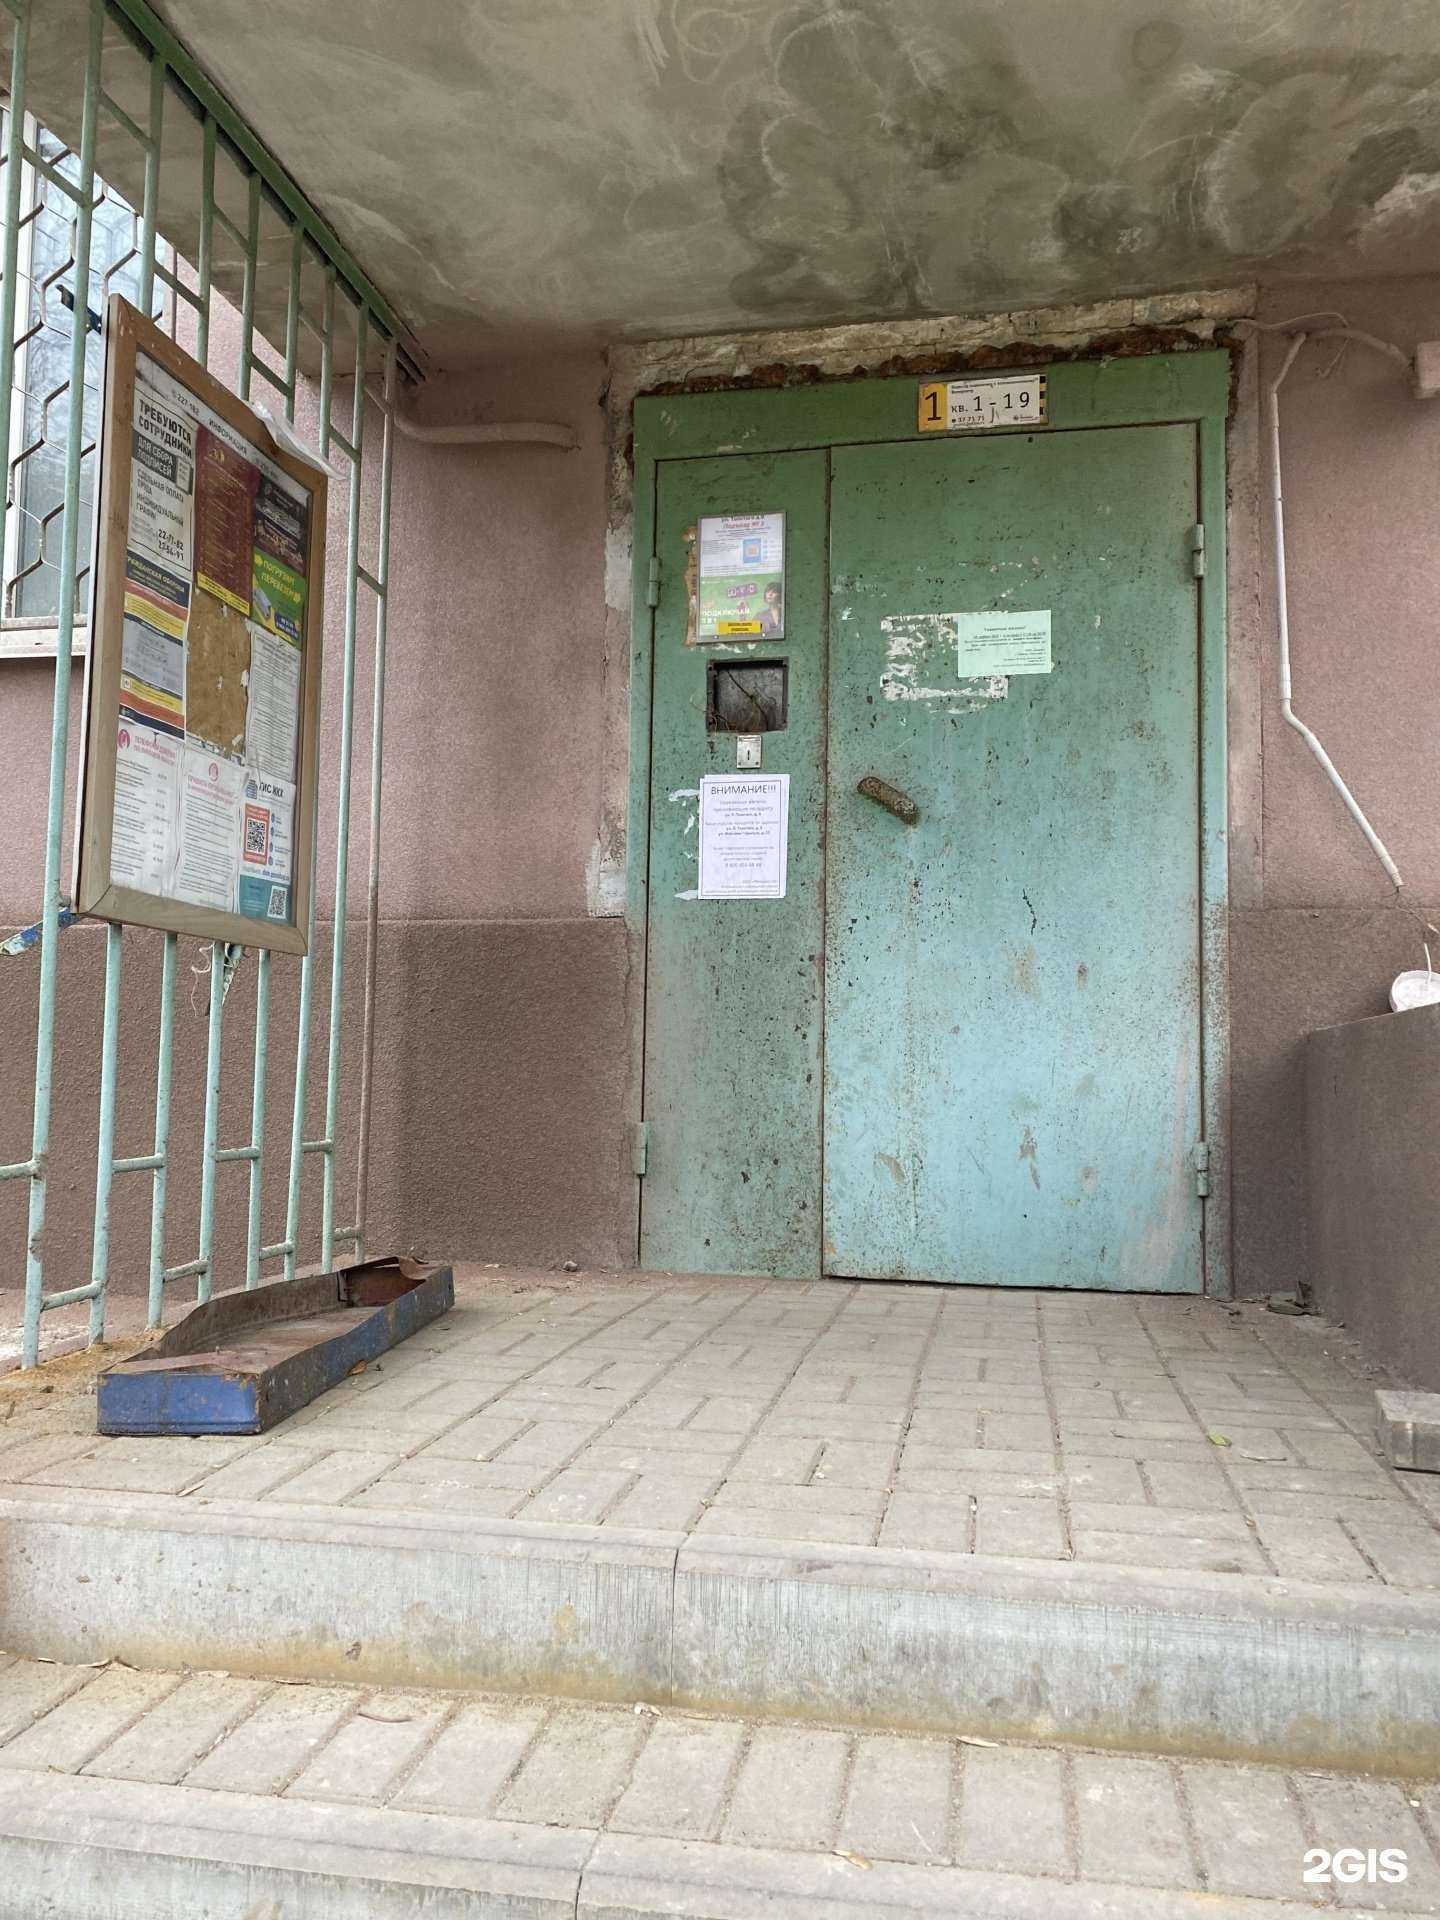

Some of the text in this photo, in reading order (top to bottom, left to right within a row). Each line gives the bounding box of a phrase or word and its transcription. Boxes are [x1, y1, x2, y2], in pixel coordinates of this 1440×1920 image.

[139, 398, 192, 446] ТРЕБУЮТСЯ
[924, 391, 943, 422] 1
[138, 415, 192, 460] СОТРУДНИКИ
[711, 784, 777, 795] ВНИМАНИЕ!!!
